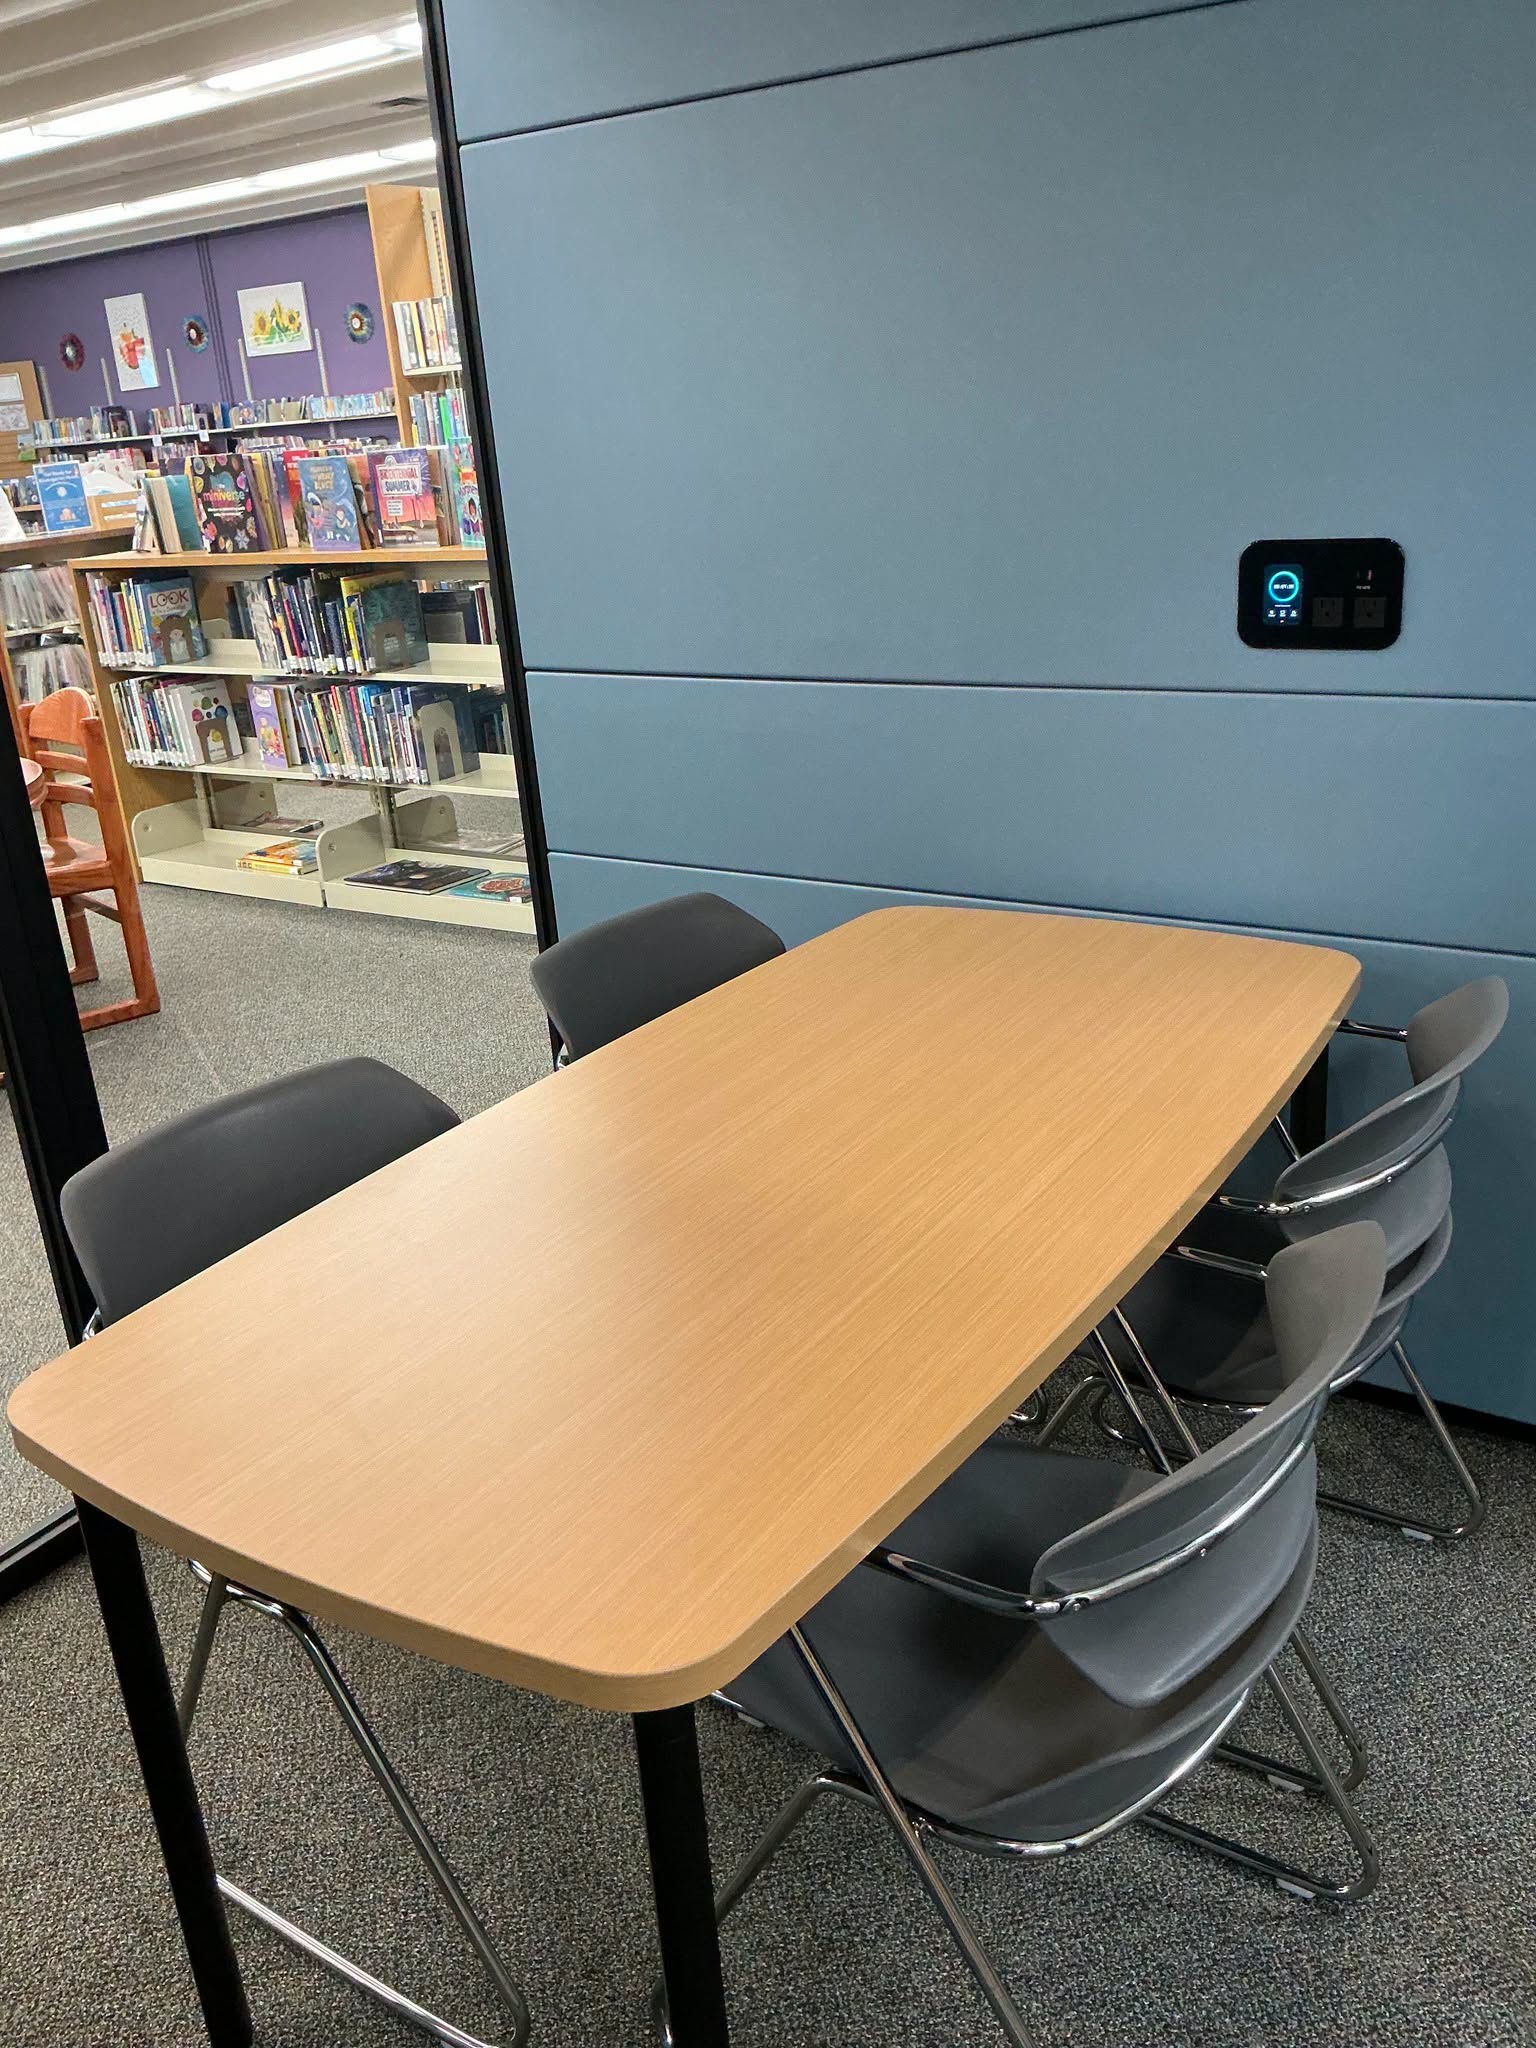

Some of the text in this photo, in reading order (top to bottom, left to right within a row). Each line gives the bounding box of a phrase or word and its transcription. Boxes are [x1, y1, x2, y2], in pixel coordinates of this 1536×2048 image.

[384, 480, 411, 492] SUMMER
[203, 488, 245, 501] miniverse
[149, 590, 189, 608] LOOK
